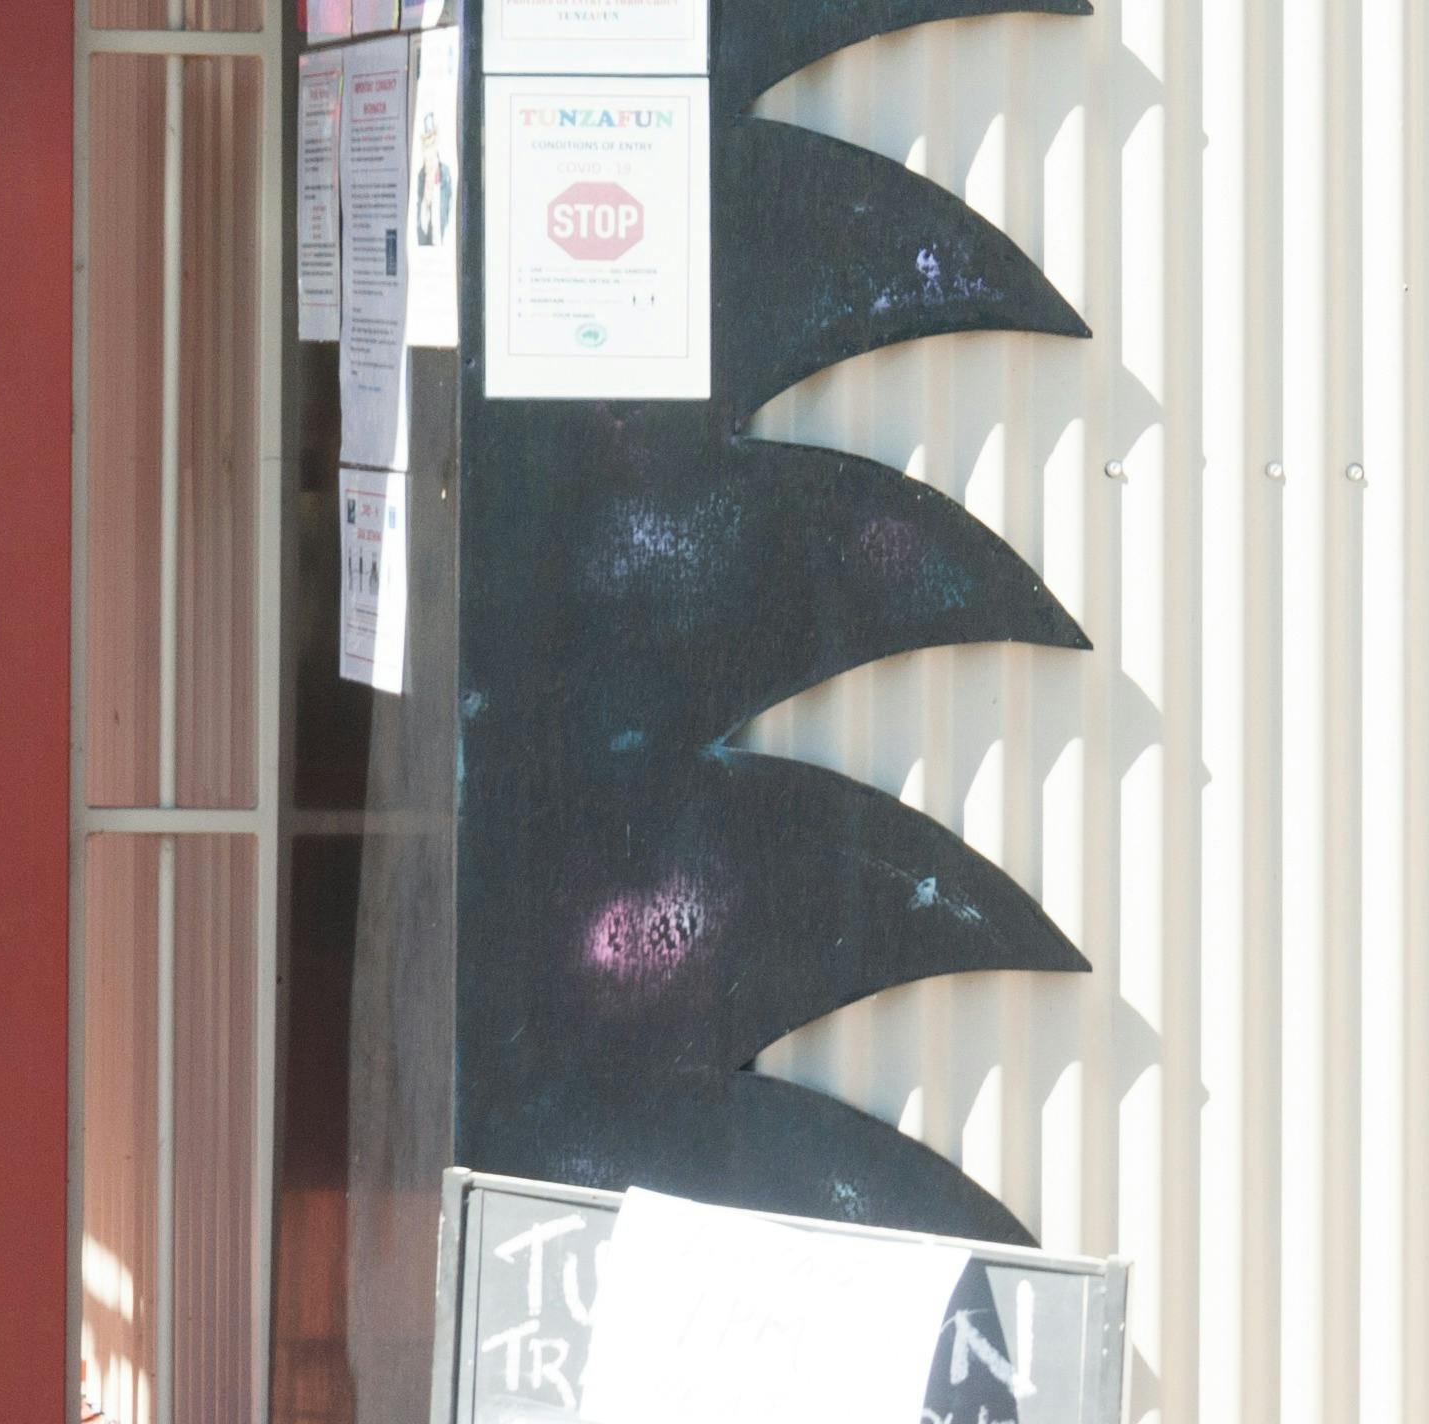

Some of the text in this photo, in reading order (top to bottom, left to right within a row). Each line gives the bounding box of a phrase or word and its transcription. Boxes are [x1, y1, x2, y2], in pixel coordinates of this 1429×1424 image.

[519, 108, 674, 128] TUNZAFUN
[531, 140, 653, 152] CONDITIONS OF ENTRY
[556, 161, 602, 175] COVID
[552, 203, 638, 240] STOP
